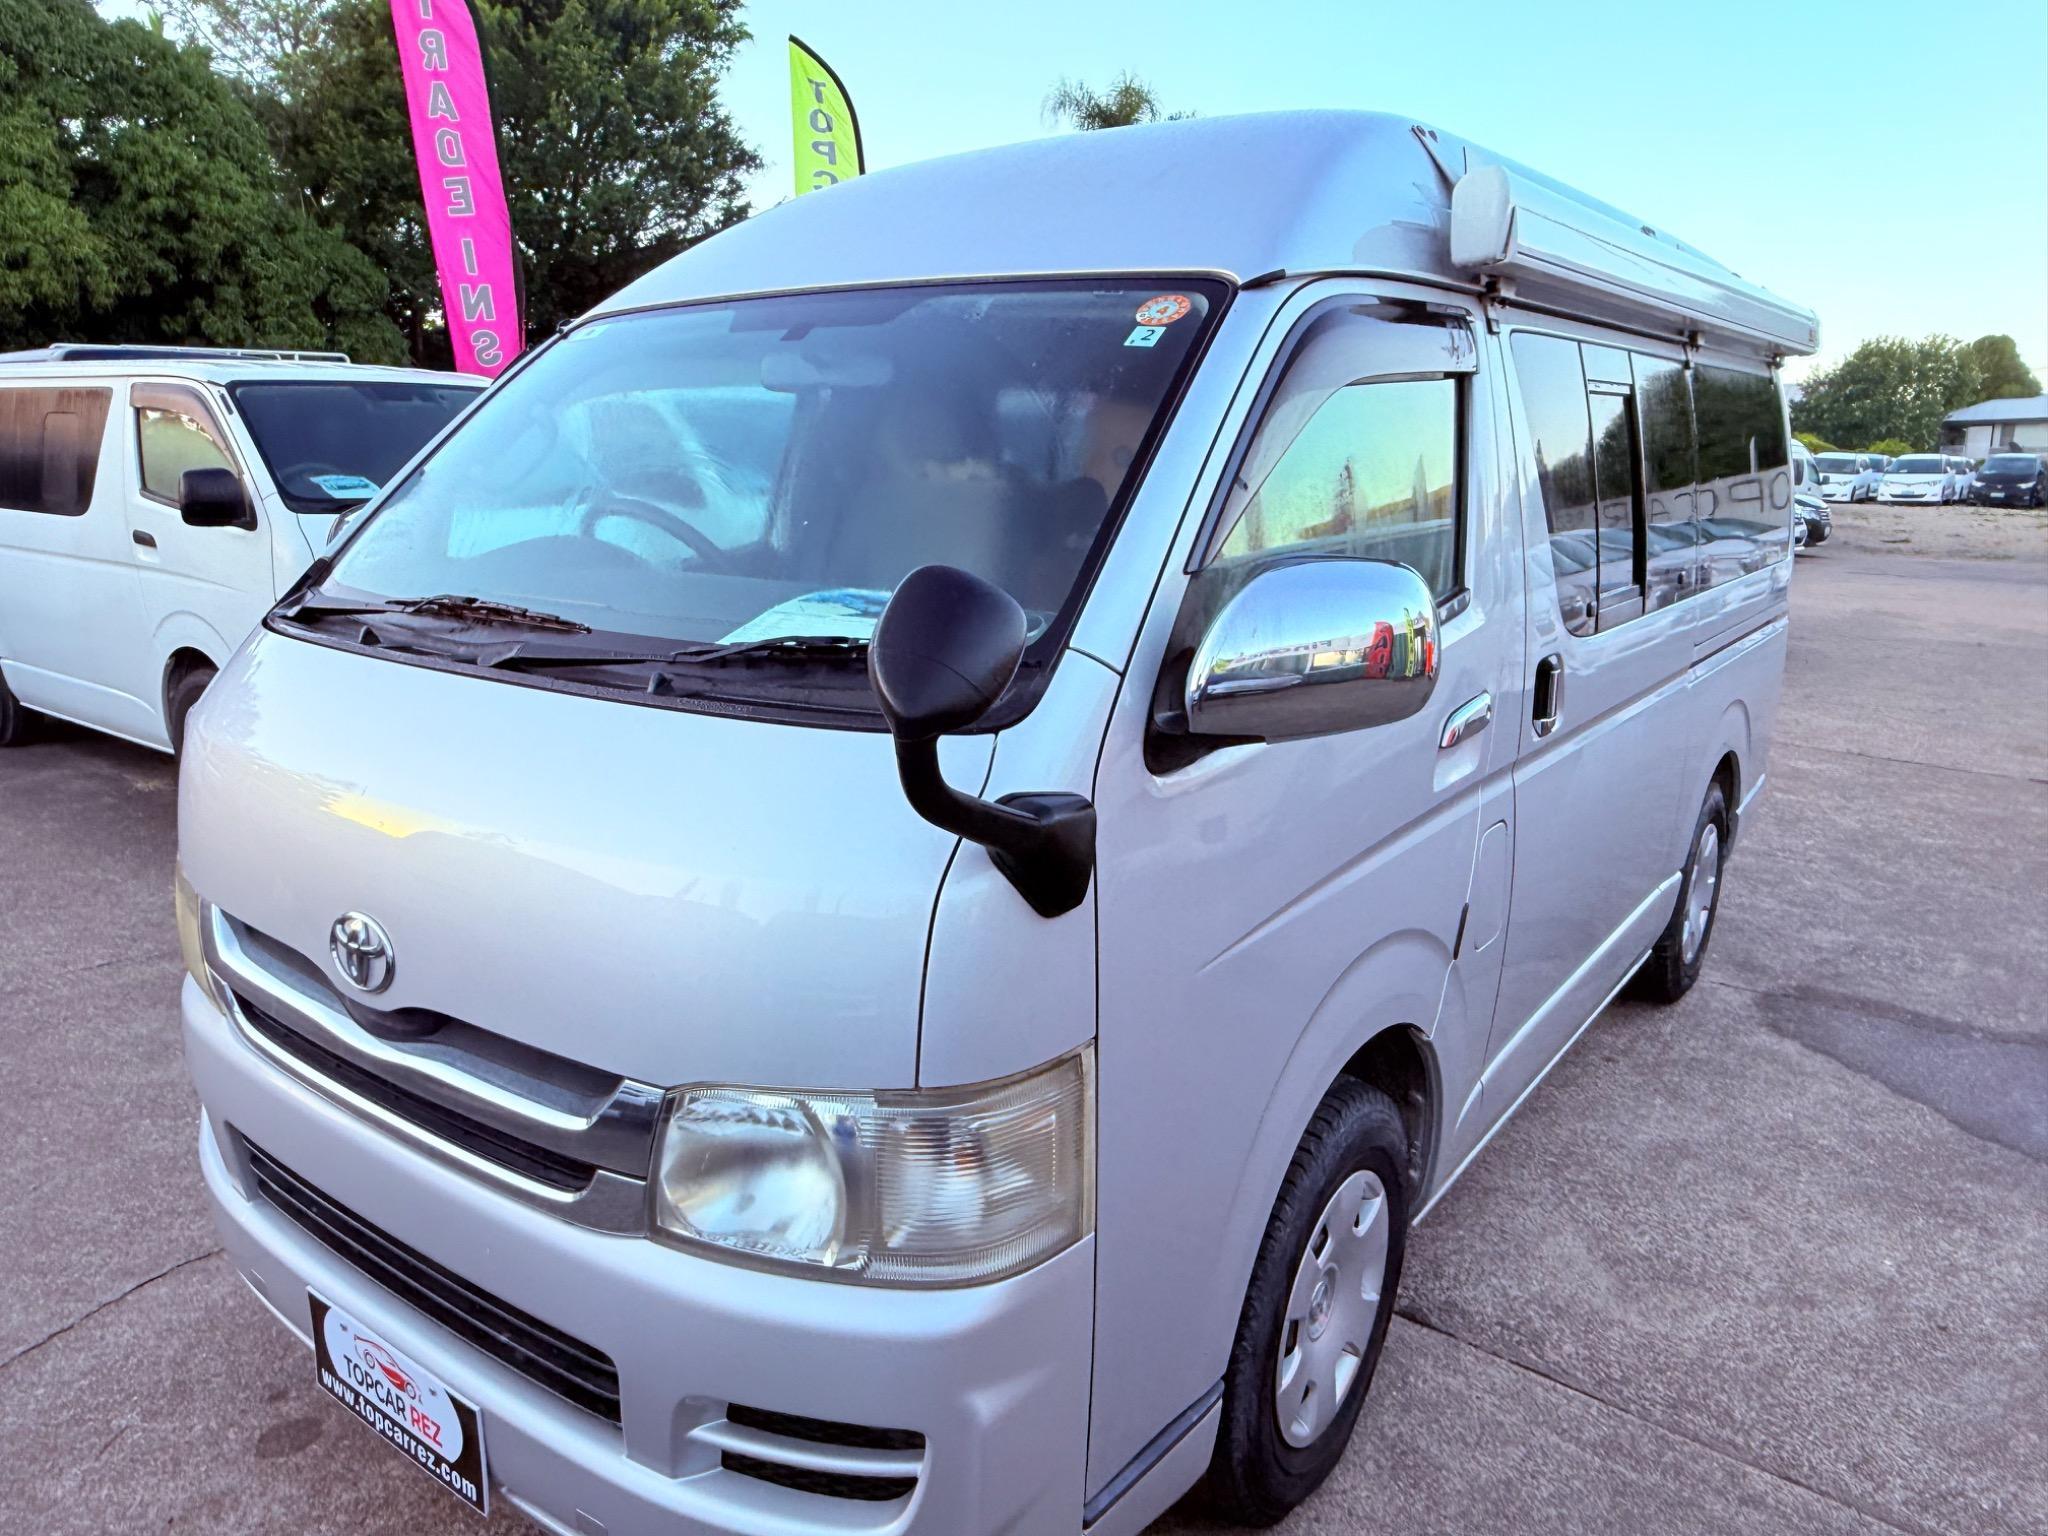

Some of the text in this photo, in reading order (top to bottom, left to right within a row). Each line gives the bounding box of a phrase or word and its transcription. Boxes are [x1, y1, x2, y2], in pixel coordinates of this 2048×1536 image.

[321, 1367, 477, 1503] www.topcarrez.com
[343, 1353, 443, 1449] TOPCAR REZ
